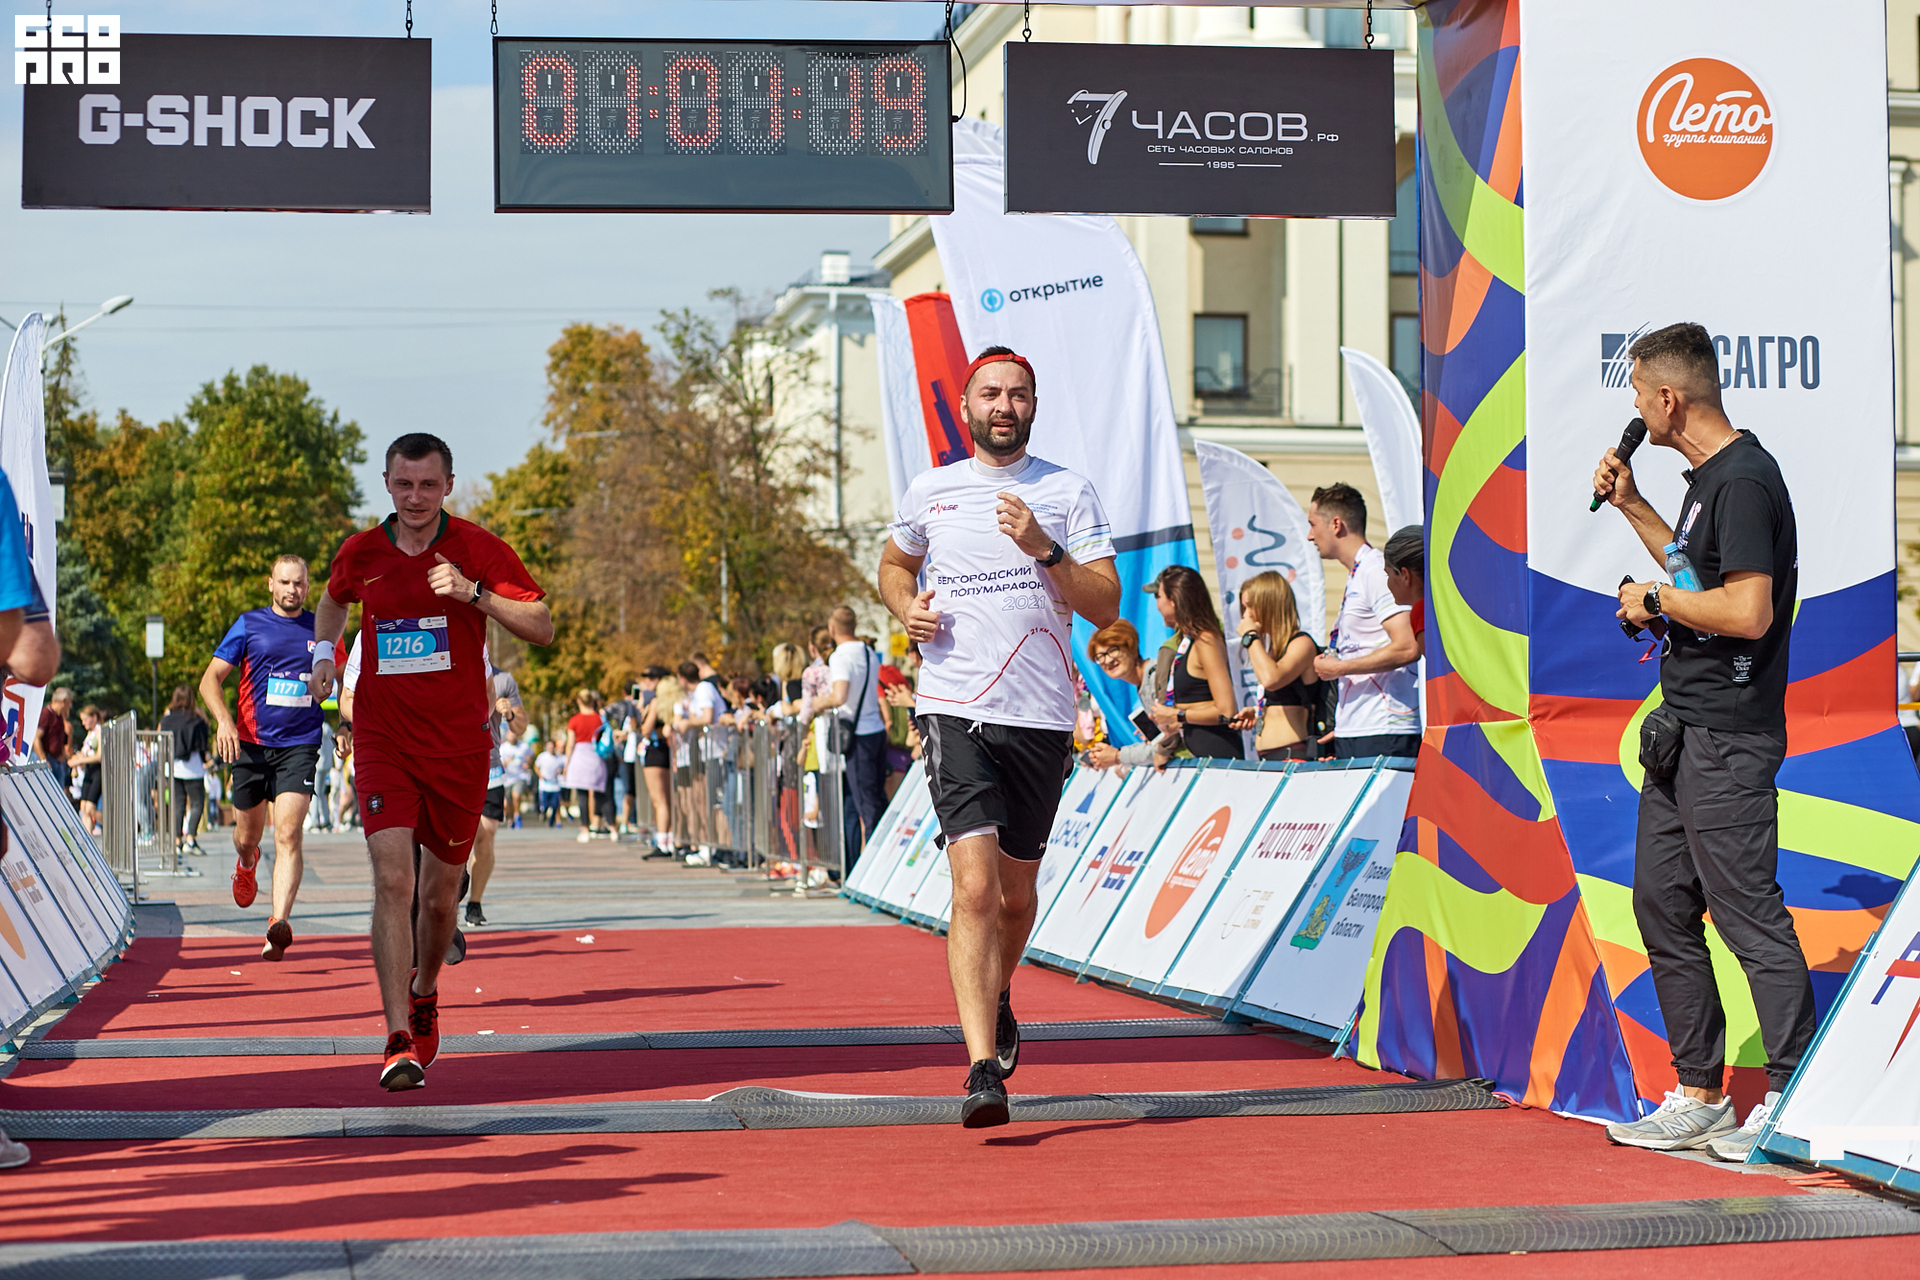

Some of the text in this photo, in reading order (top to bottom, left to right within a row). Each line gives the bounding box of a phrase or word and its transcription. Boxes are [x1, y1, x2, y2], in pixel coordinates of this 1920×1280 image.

[523, 55, 926, 148] 01:01:19
[1646, 72, 1772, 143] Лето
[78, 92, 376, 149] G-SHOCK
[1147, 145, 1294, 155] СЕТЬ ЧАСОВЫХ САЛОНОВ
[1662, 133, 1706, 148] группа
[1206, 161, 1235, 169] 1995
[1009, 275, 1103, 302] открытие
[1712, 334, 1821, 390] САГРО
[937, 565, 1032, 585] БЕЛГОРОДСКИЙ
[950, 580, 1046, 598] ПОЛУМАРАФОН
[1002, 594, 1046, 611] 2021
[1030, 627, 1038, 635] 21
[386, 635, 424, 655] 1216
[274, 682, 299, 695] 1171
[1362, 861, 1392, 883] Прави
[1345, 888, 1386, 913] Белгород
